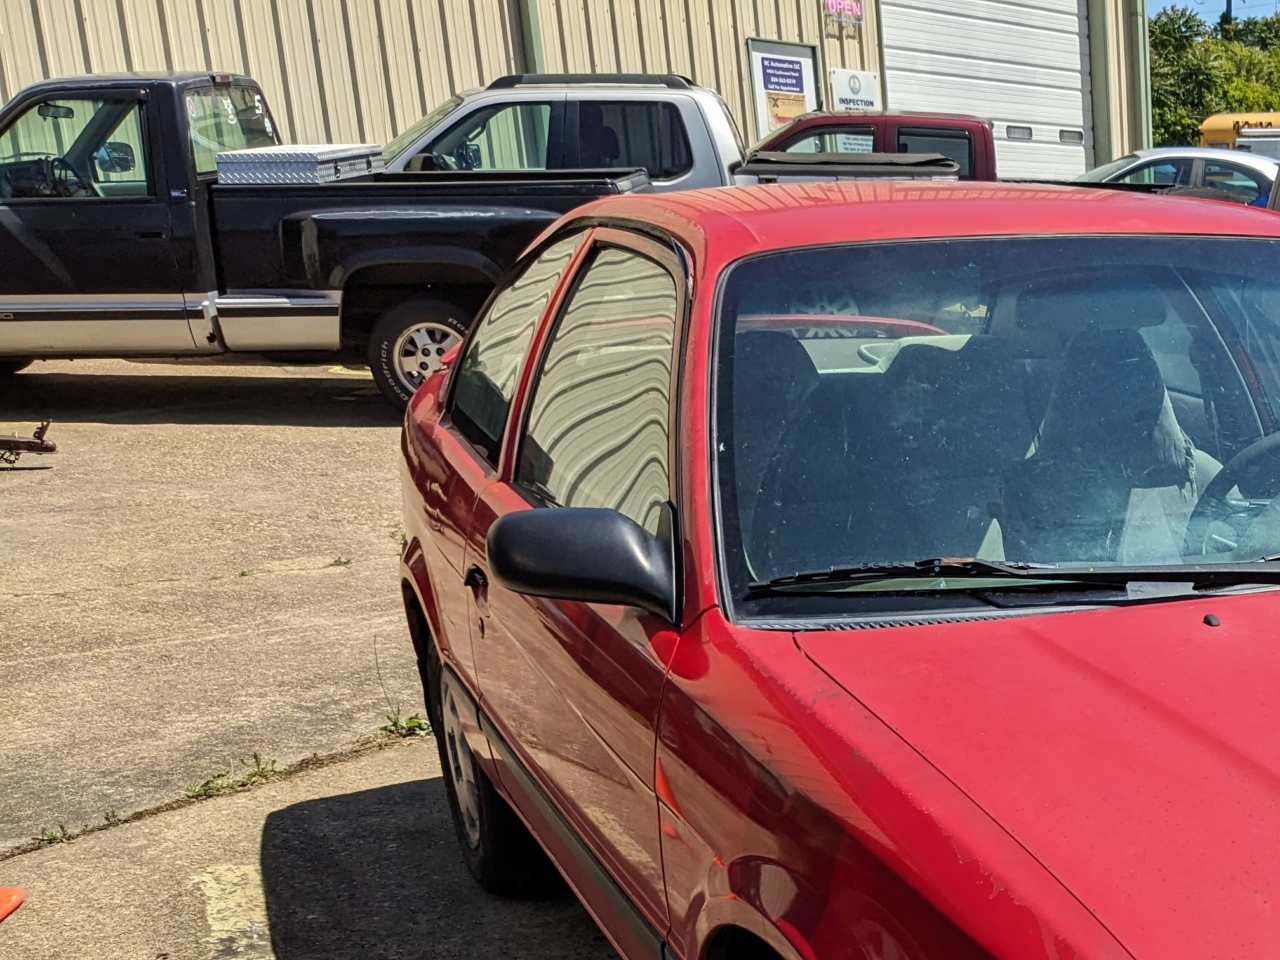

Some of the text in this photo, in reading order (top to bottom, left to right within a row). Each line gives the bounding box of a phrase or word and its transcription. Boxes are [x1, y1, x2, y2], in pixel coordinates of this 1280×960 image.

[828, 0, 861, 15] OPEN
[771, 60, 793, 69] Automotive
[839, 98, 874, 107] INSPECTION
